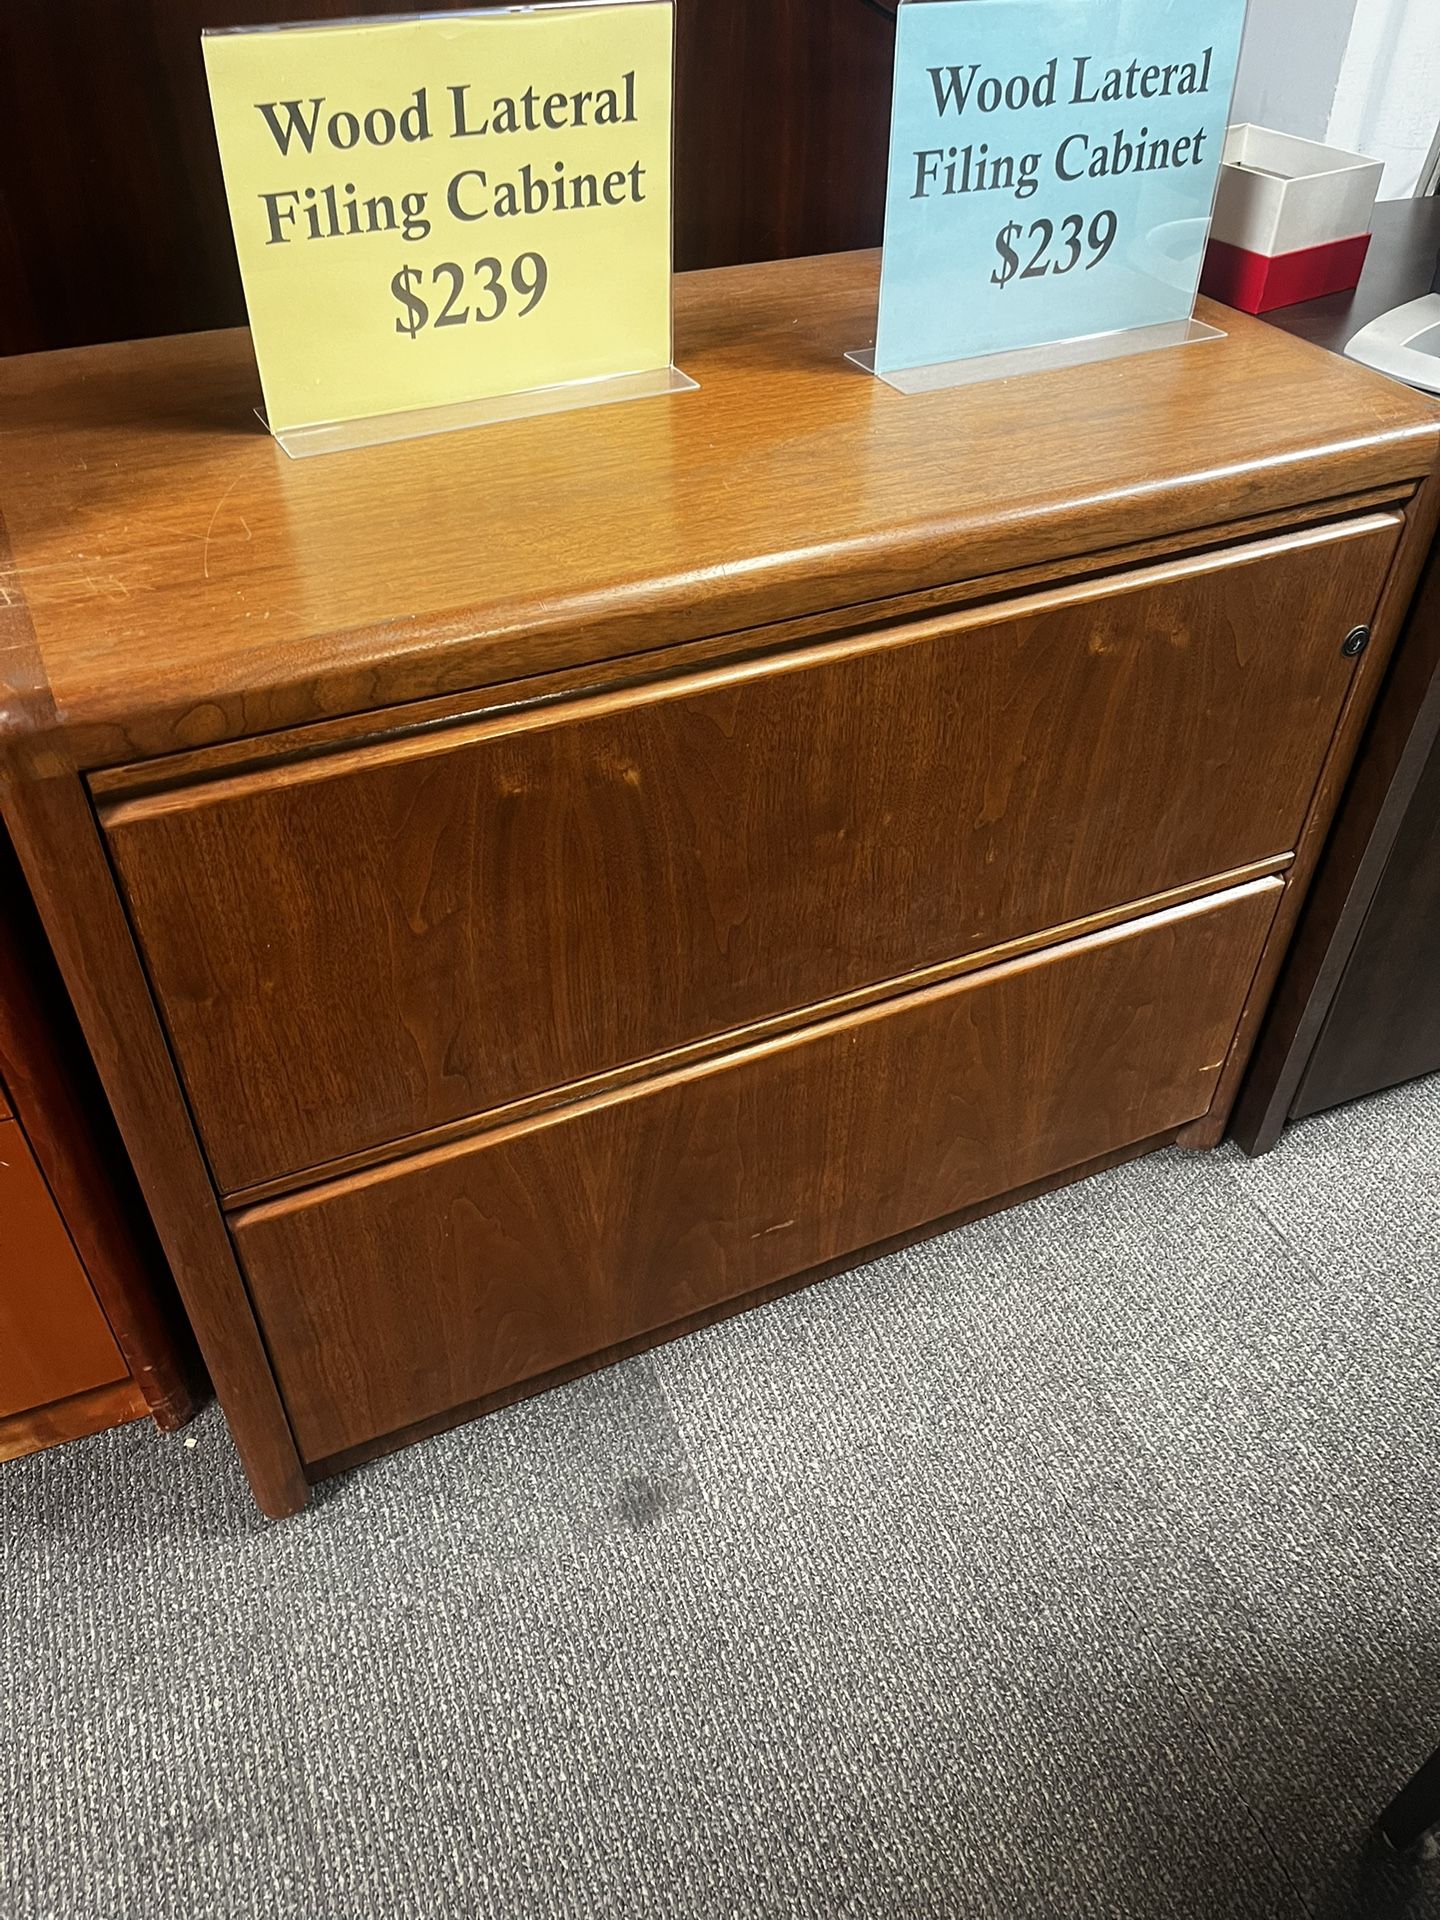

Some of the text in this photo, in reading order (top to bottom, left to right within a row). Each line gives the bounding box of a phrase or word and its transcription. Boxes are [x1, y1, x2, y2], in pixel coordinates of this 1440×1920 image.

[254, 70, 638, 156] Wood Lateral
[926, 46, 1213, 117] Wood Lateral
[258, 160, 647, 245] Filing Cabinet
[909, 126, 1208, 199] Filing Cabinet
[989, 209, 1118, 289] $239
[389, 251, 549, 339] $239
